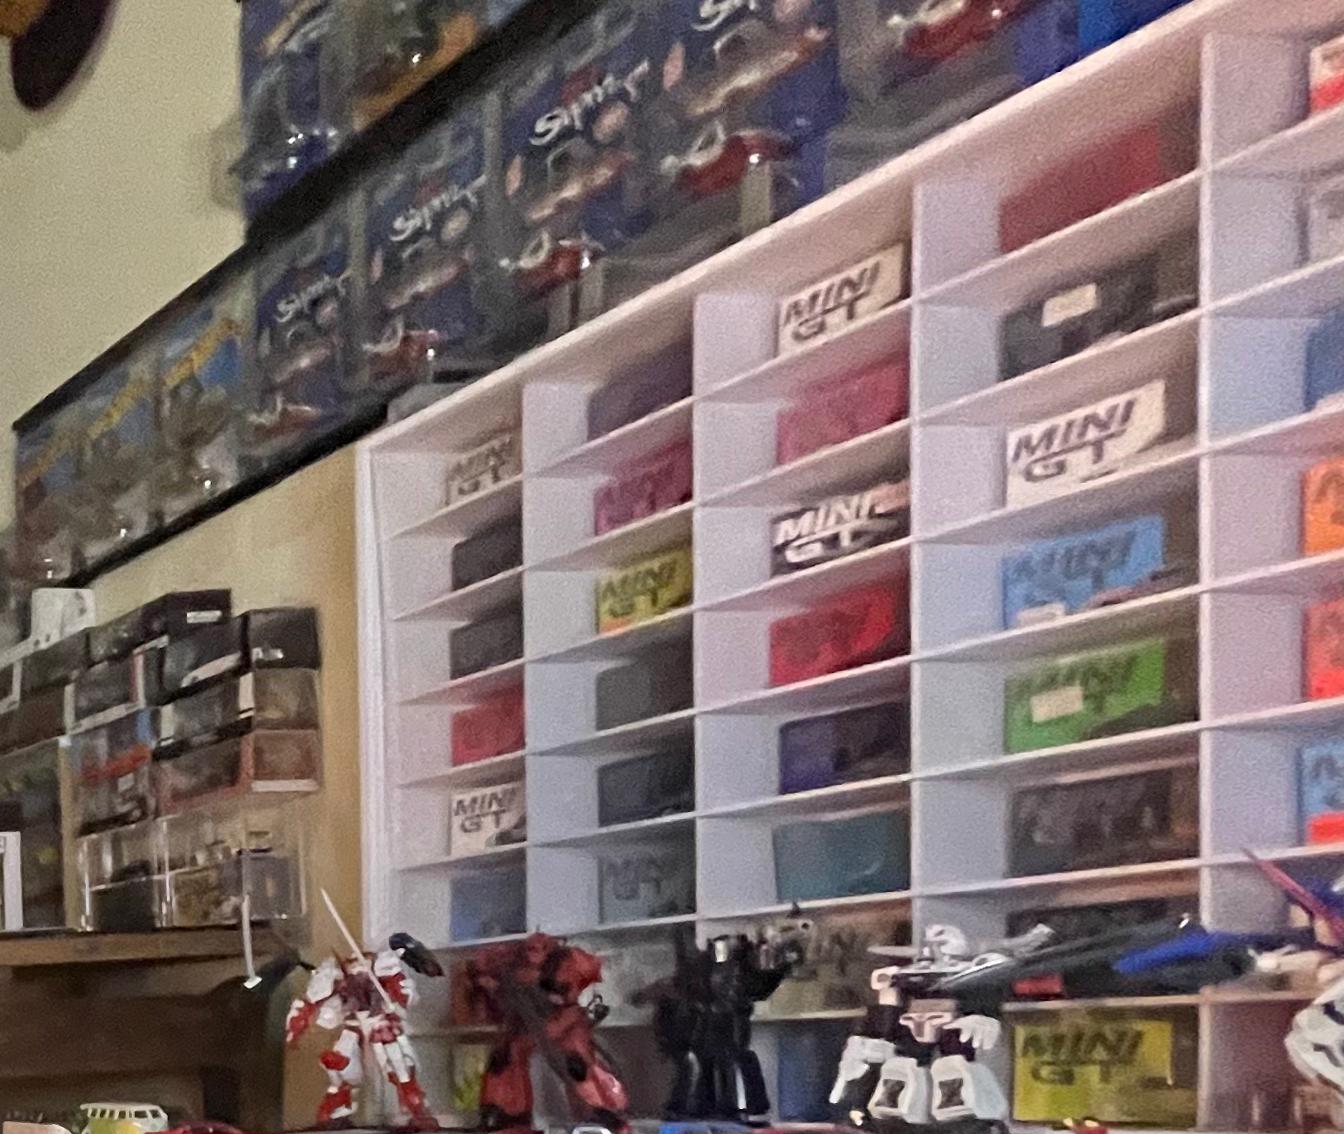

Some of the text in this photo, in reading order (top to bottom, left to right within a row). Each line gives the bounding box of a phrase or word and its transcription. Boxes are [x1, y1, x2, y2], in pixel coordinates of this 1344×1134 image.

[783, 261, 880, 327] MINI
[792, 289, 871, 341] GT
[1013, 398, 1137, 463] MINI
[1024, 427, 1127, 482] GT
[774, 493, 872, 546] MINI
[785, 518, 878, 563] GT
[454, 786, 516, 816] MINI
[461, 808, 507, 834] GT
[1022, 1028, 1144, 1062] MINI
[1030, 1056, 1134, 1086] GT
